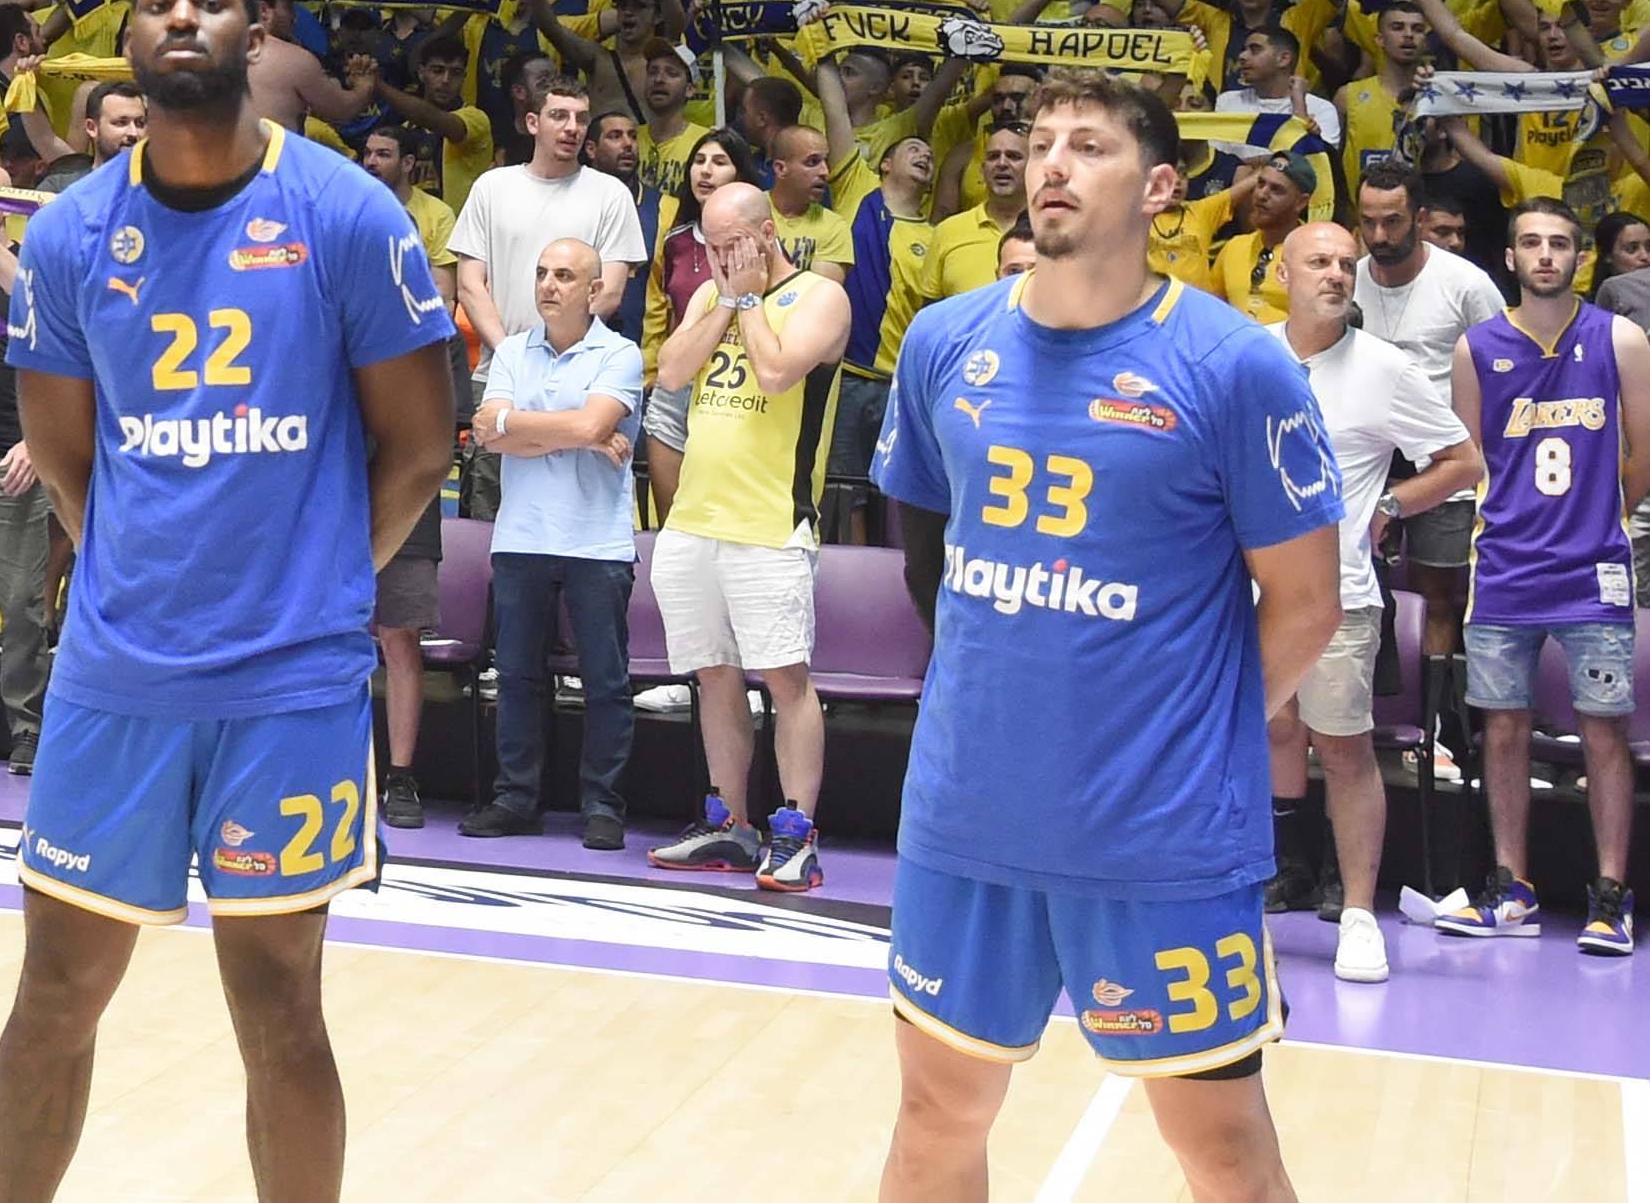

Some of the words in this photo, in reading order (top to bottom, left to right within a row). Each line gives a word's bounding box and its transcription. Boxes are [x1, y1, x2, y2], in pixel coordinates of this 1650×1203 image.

[824, 10, 912, 42] FVCK
[1027, 31, 1173, 64] HAPOEL
[151, 308, 252, 391] 22
[705, 351, 749, 390] 25
[1503, 397, 1607, 438] LAKERS
[981, 443, 1095, 539] 33
[1533, 436, 1572, 497] 8
[35, 837, 91, 873] Rapyd
[279, 778, 361, 878] 22
[893, 953, 944, 997] Rapyd
[1154, 931, 1263, 1035] 33
